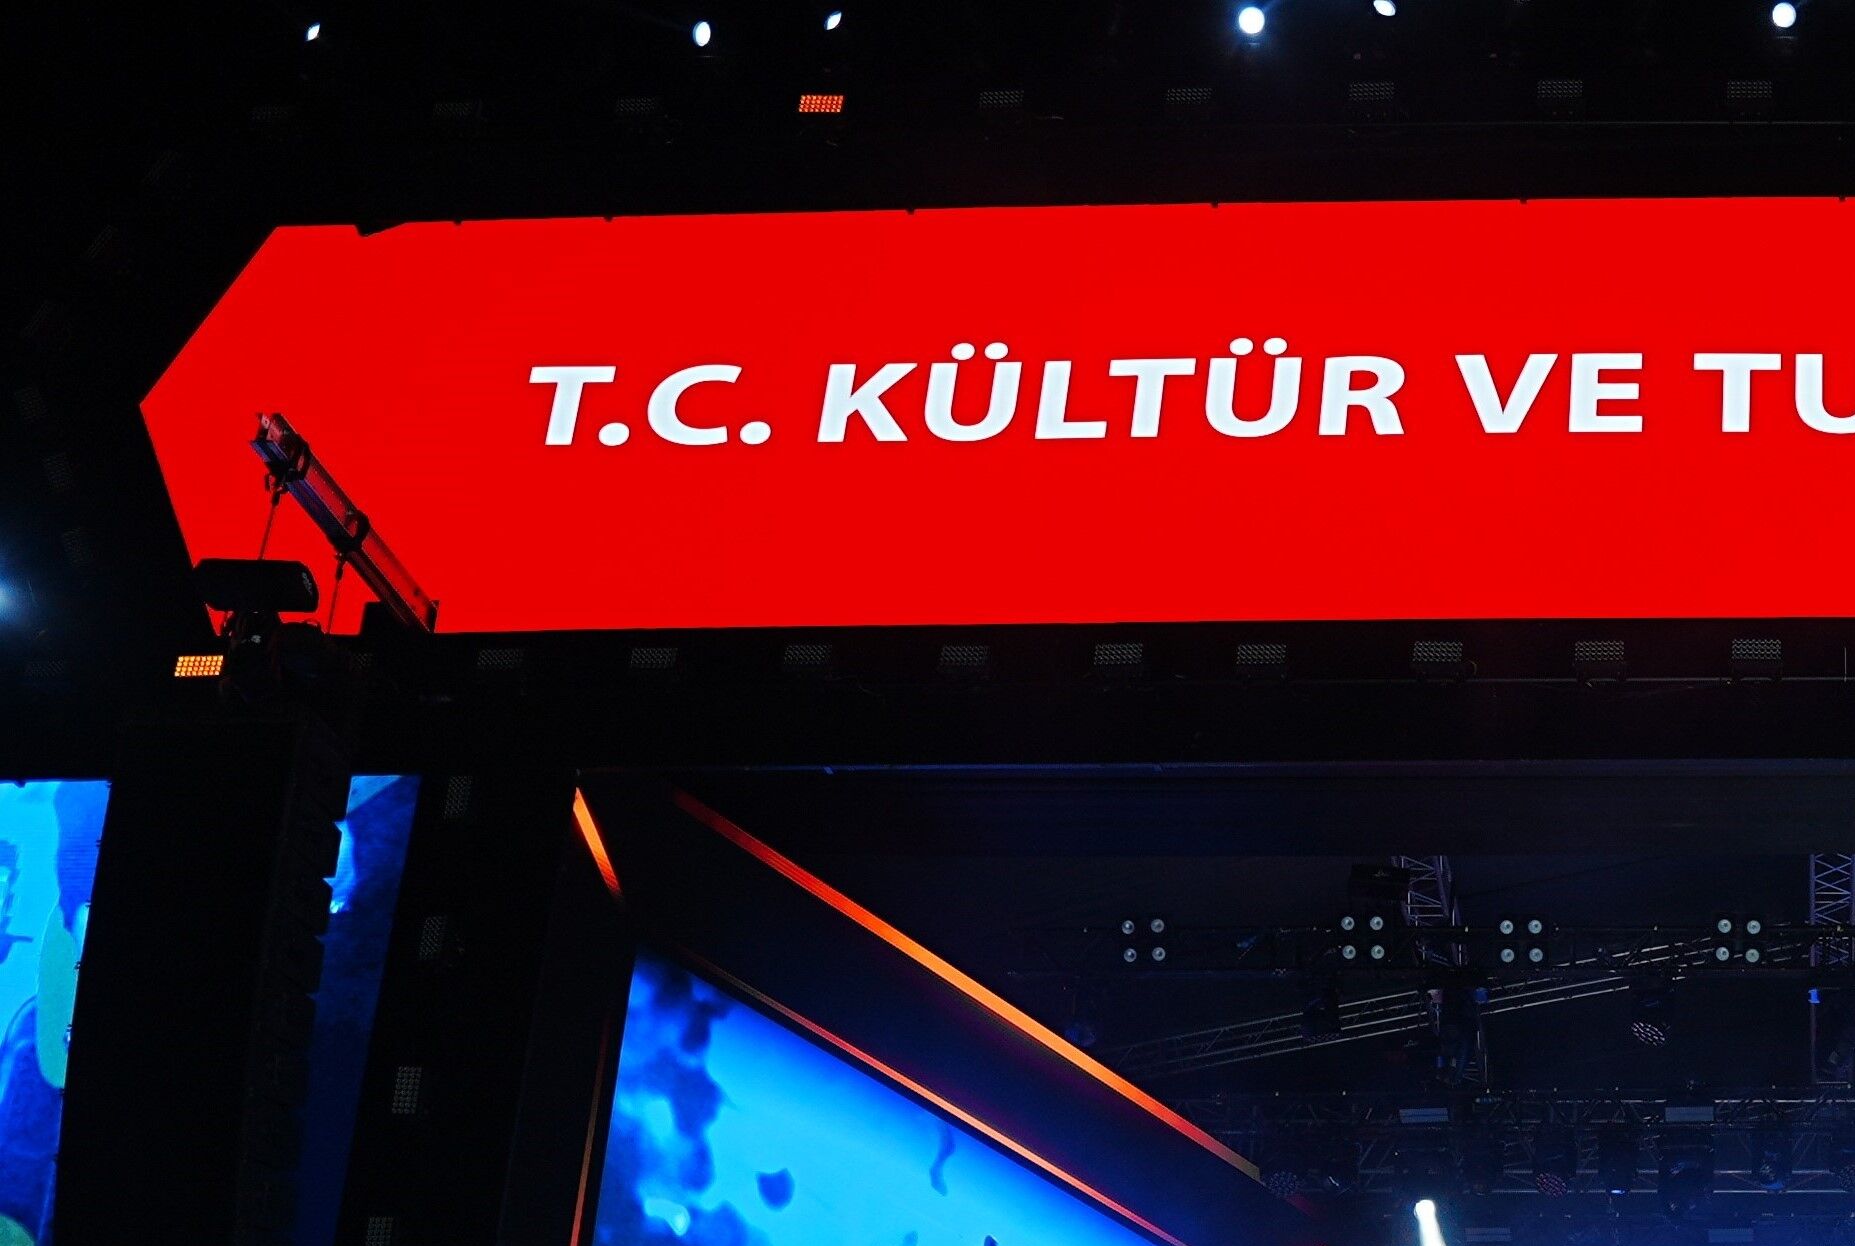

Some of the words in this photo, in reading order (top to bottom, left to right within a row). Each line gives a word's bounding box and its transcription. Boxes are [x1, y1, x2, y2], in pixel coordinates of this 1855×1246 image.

[529, 362, 772, 447] T.C.
[817, 338, 1405, 444] KÜLTÜR
[1454, 352, 1643, 434] VE
